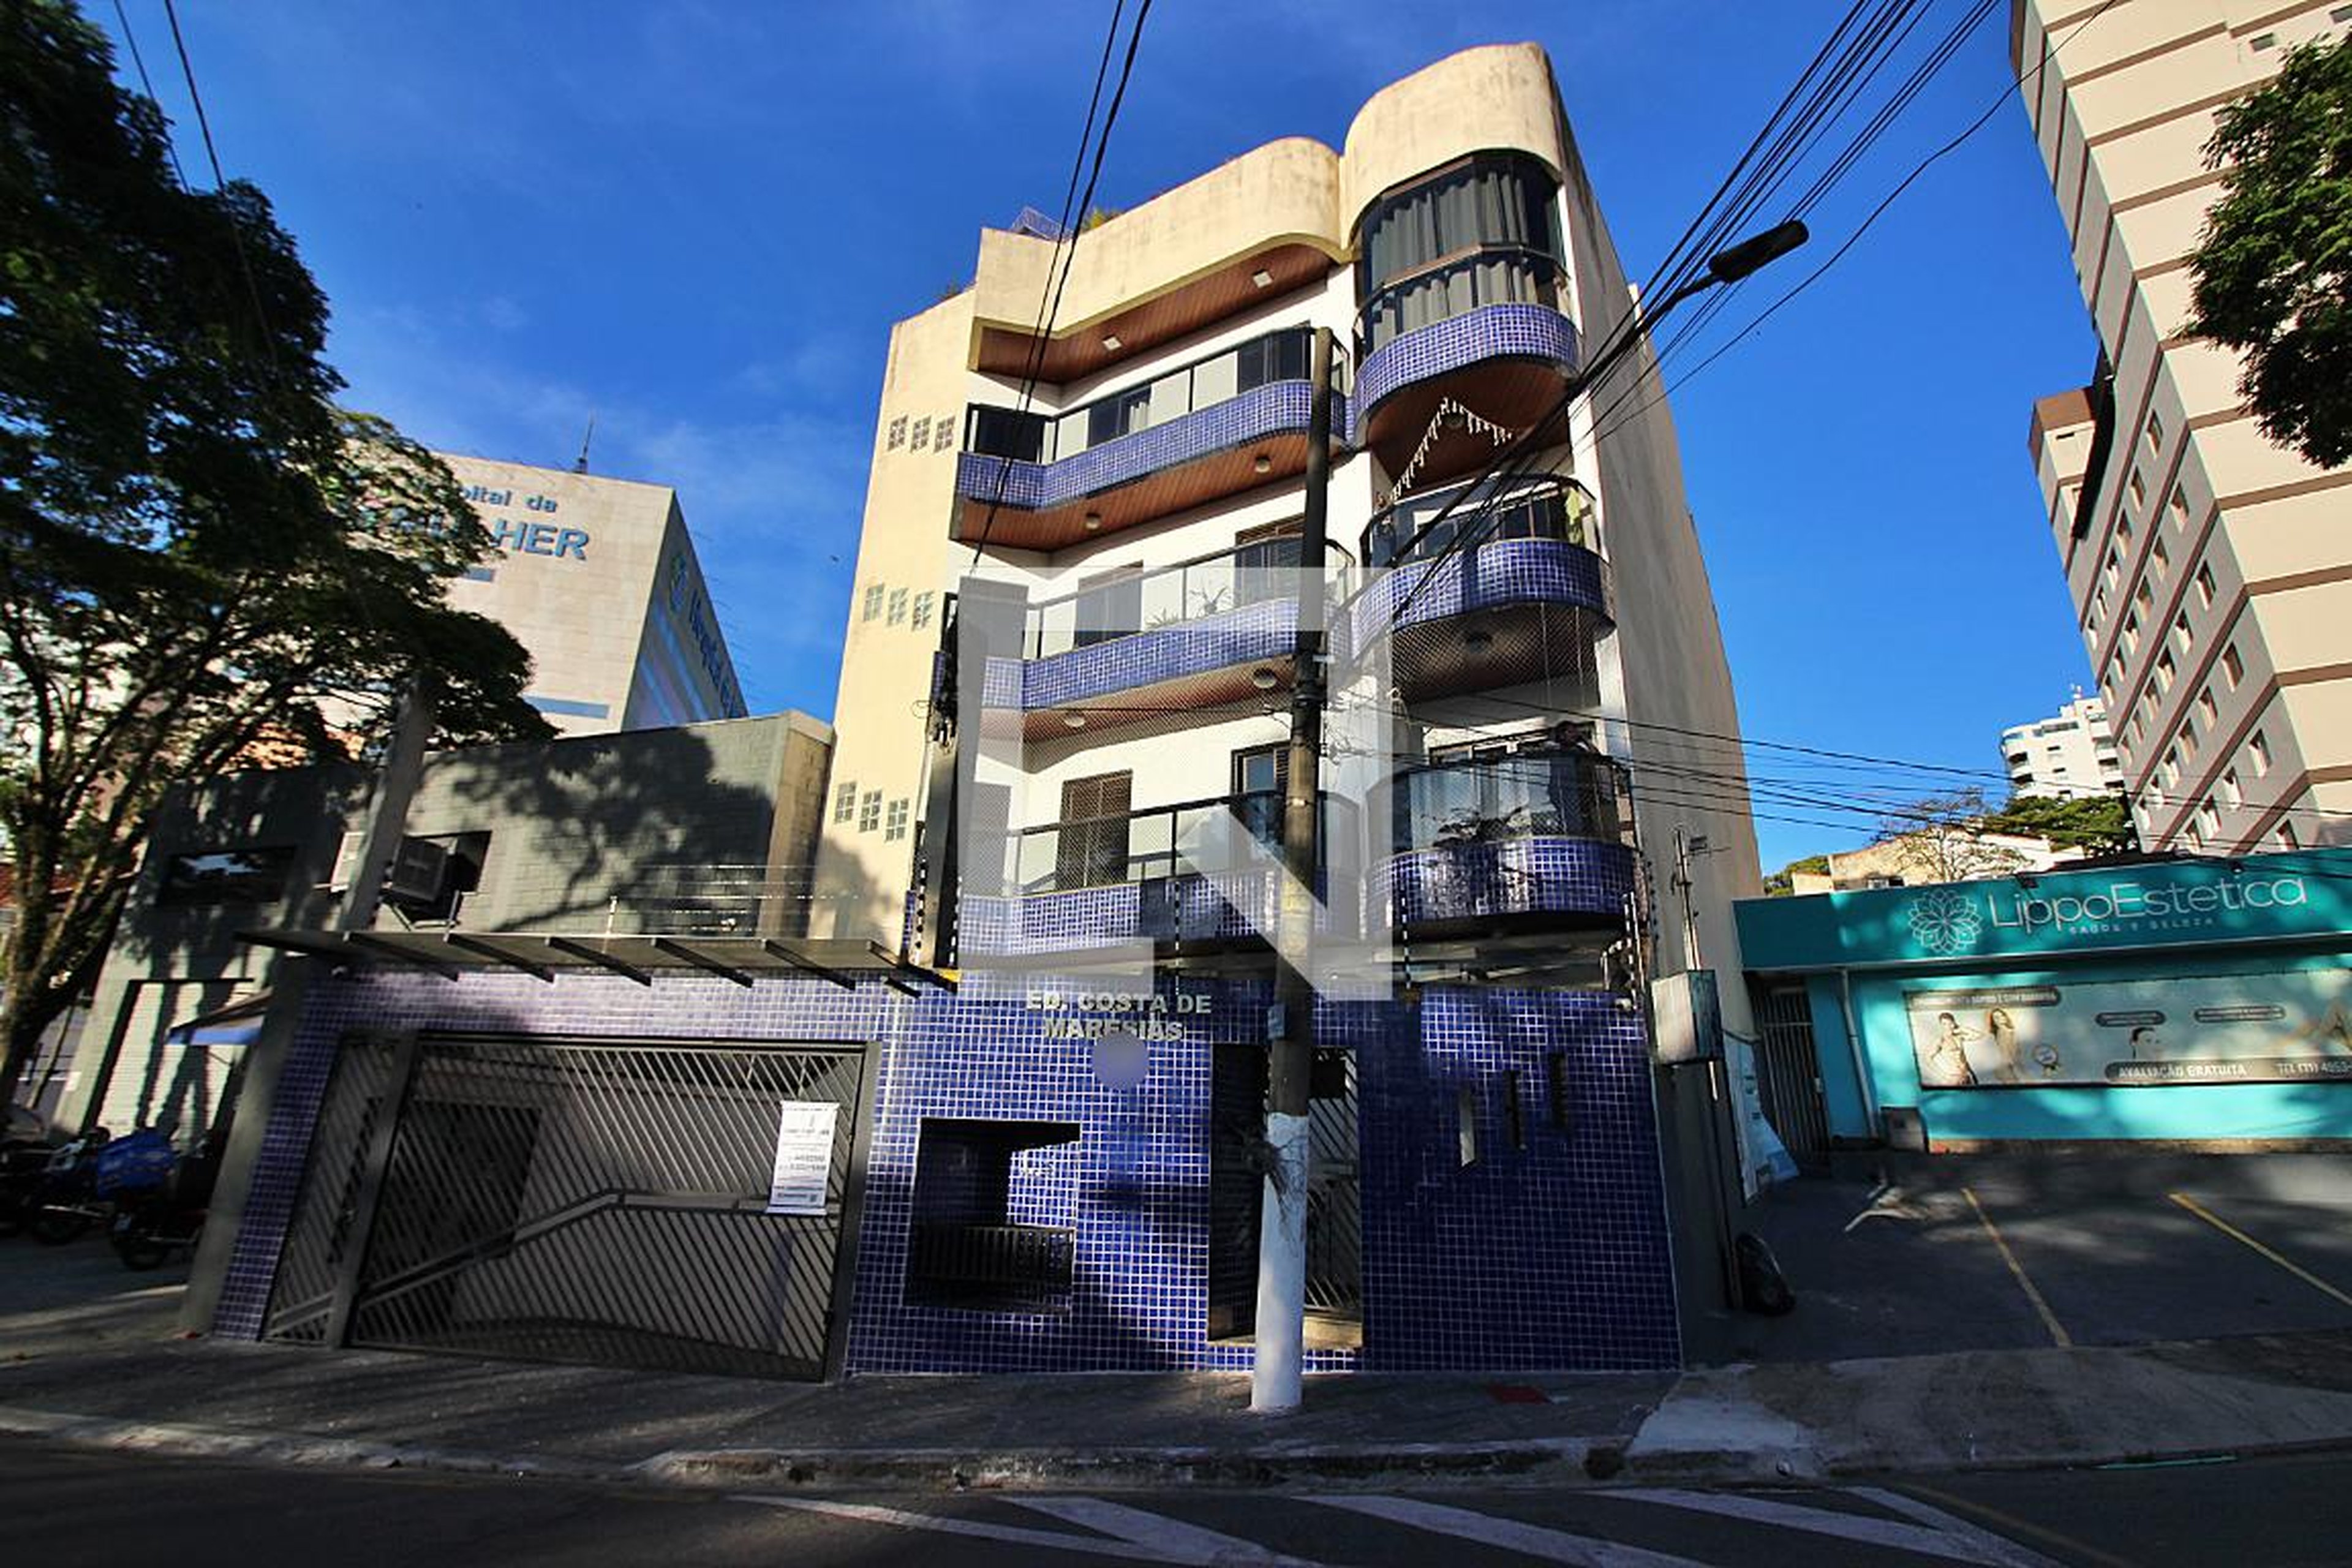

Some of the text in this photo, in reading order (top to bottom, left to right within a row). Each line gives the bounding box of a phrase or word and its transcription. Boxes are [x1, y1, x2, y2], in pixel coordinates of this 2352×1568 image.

[526, 494, 558, 513] da
[492, 518, 589, 560] HER
[1988, 875, 2308, 933] LippoEstetica
[1027, 990, 1212, 1014] ED. COSTA DE
[1043, 1017, 1184, 1041] MARESIAS
[2118, 1063, 2184, 1078] AVALIAÇÃO
[2186, 1063, 2248, 1077] GRATUITA
